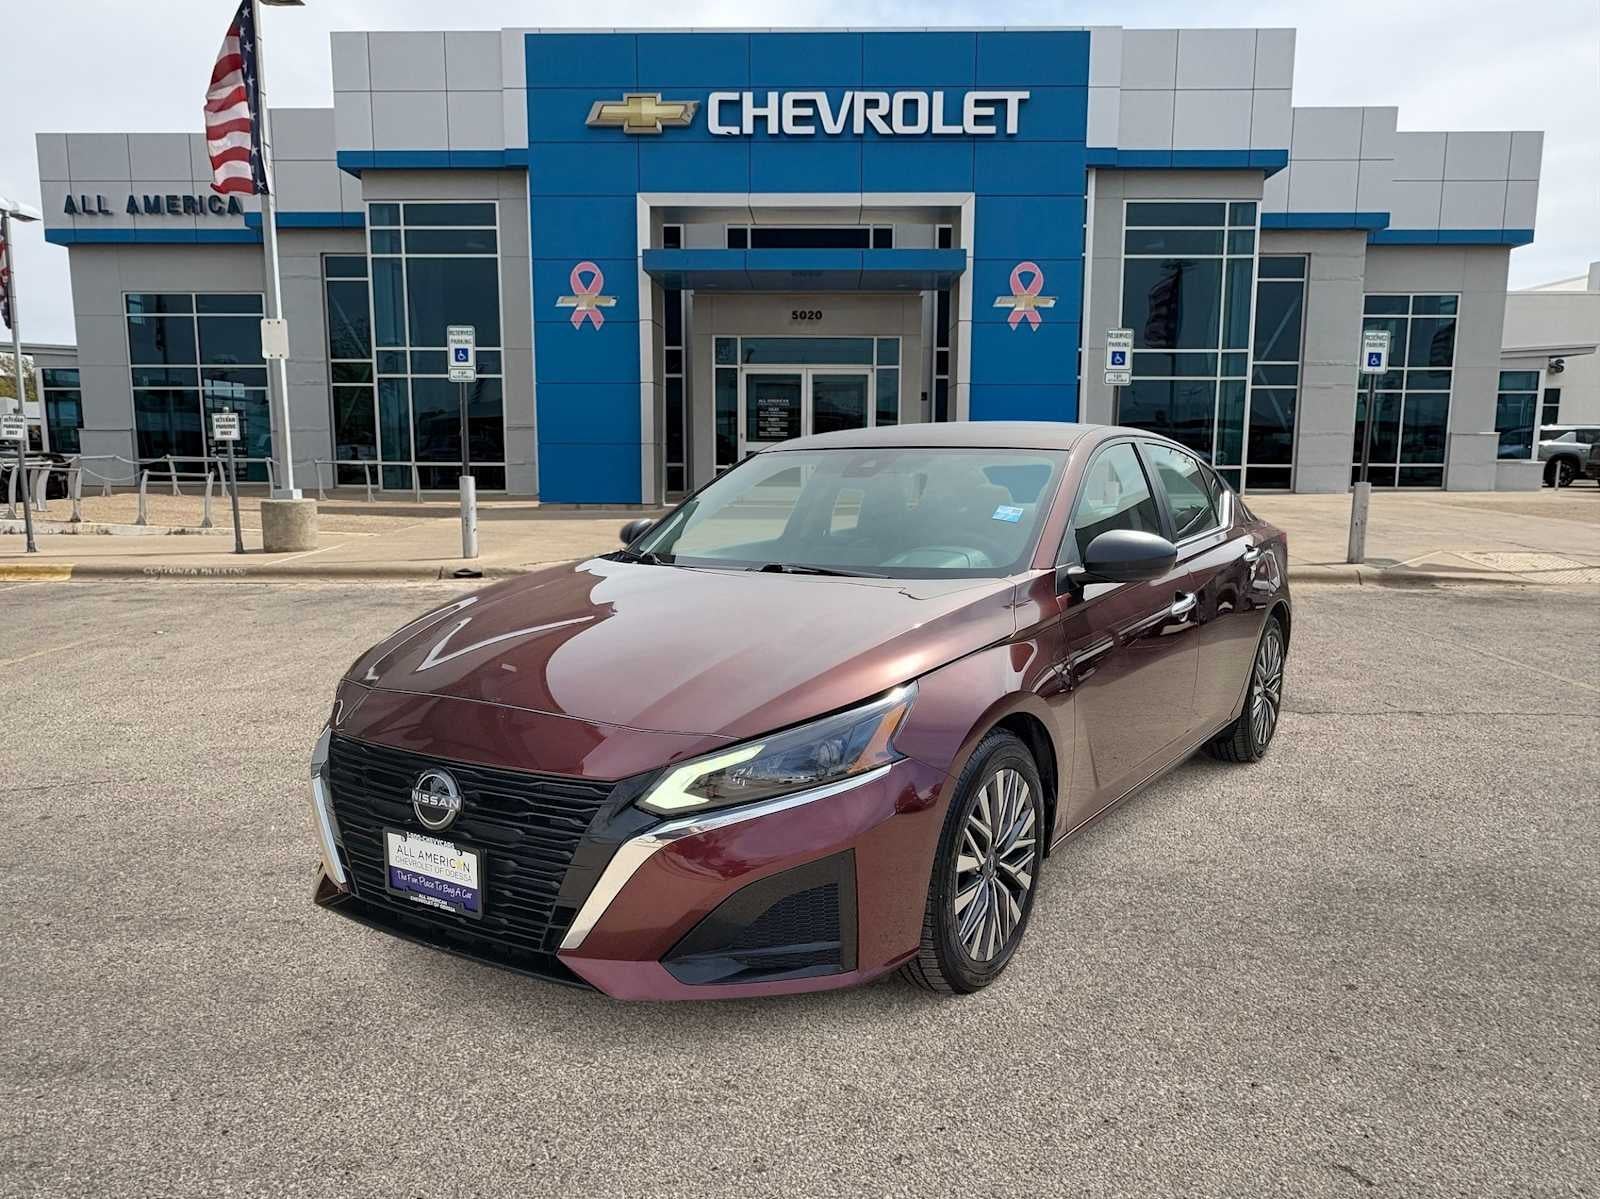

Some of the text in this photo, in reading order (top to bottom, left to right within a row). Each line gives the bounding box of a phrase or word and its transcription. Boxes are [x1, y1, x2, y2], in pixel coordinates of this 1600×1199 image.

[708, 91, 1030, 136] CHEVROLET
[64, 195, 112, 214] ALL
[791, 310, 823, 320] 5020
[411, 789, 459, 809] NISSAN
[396, 845, 415, 858] ALL
[395, 855, 433, 871] CHEVROLET
[397, 870, 407, 881] The
[419, 876, 435, 889] Place
[435, 881, 442, 891] To
[443, 884, 455, 898] Buy
